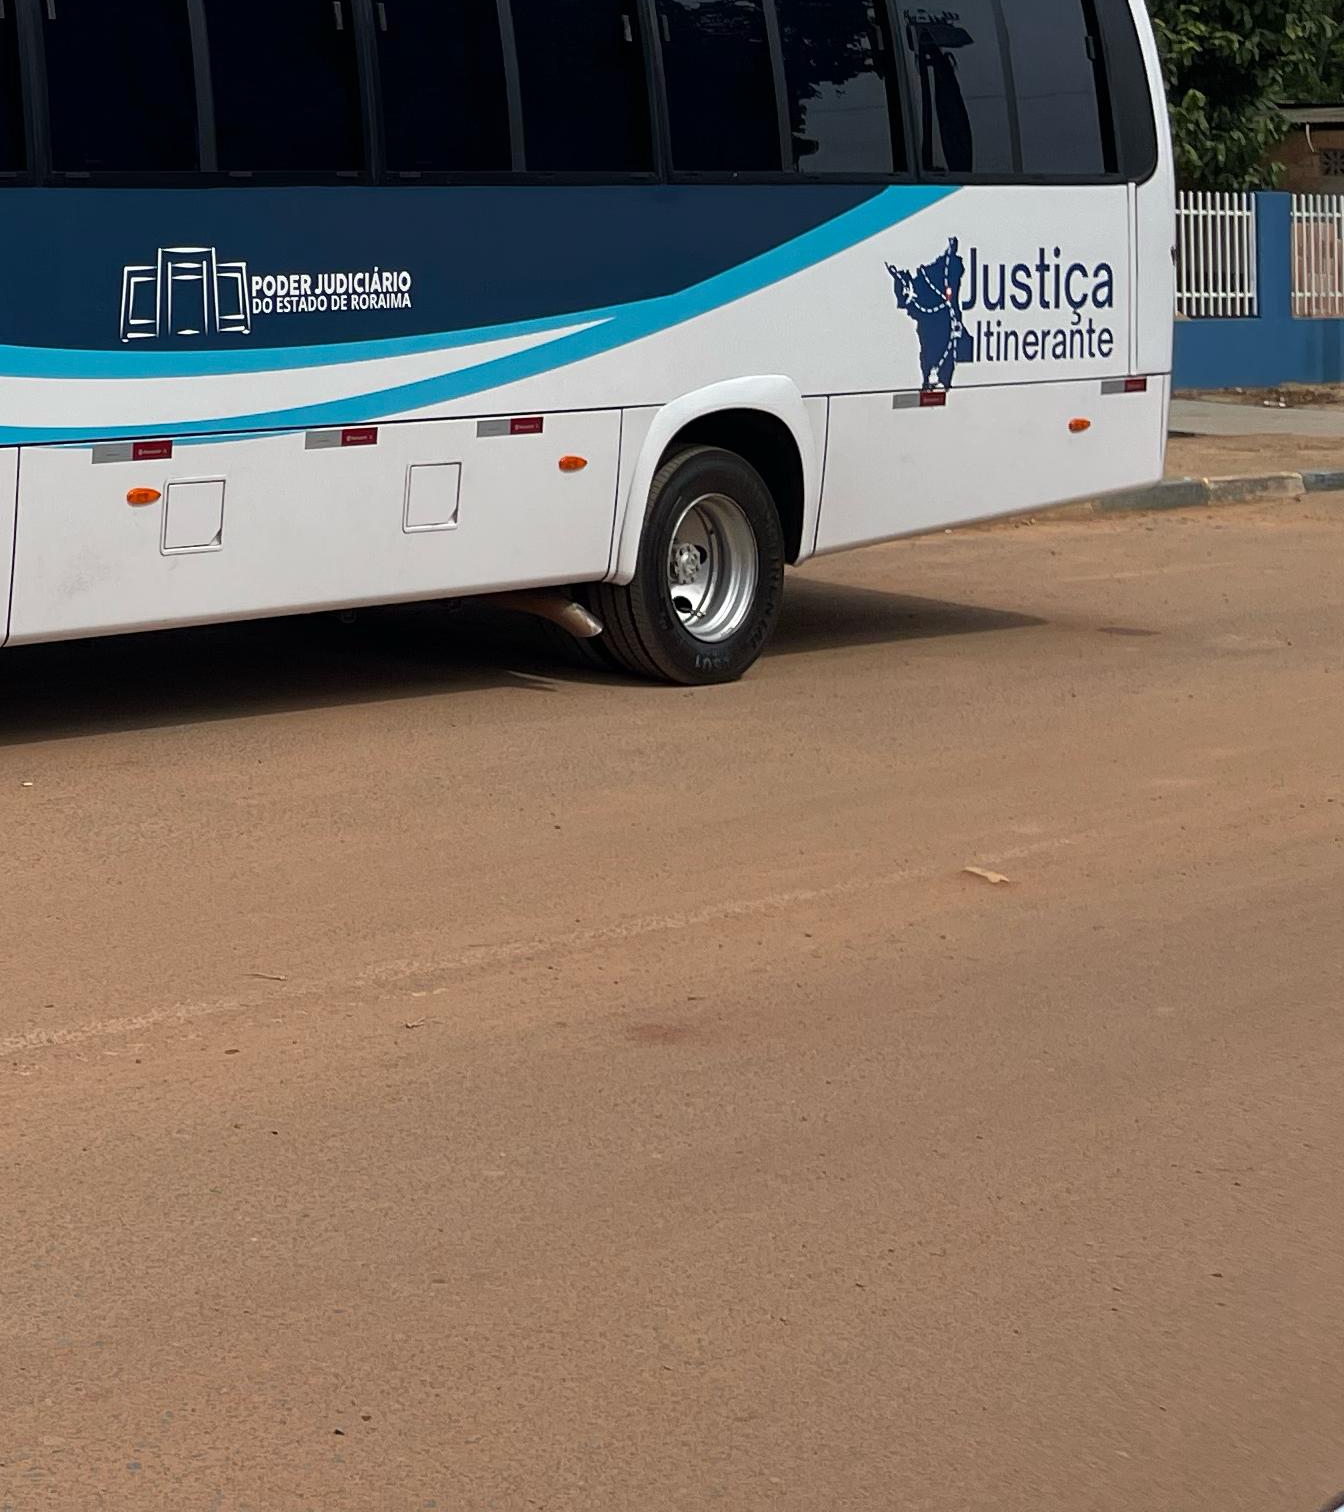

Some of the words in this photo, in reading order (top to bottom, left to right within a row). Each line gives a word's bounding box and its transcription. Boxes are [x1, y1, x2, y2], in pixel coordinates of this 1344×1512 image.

[251, 274, 312, 297] PODER
[314, 266, 412, 295] JUDICIÁRIO
[961, 246, 1113, 325] Justiça
[252, 297, 273, 314] DO
[276, 295, 328, 313] ESTADO
[330, 294, 348, 311] DE
[351, 293, 412, 310] RORAIMA
[976, 318, 1113, 362] Itinerante
